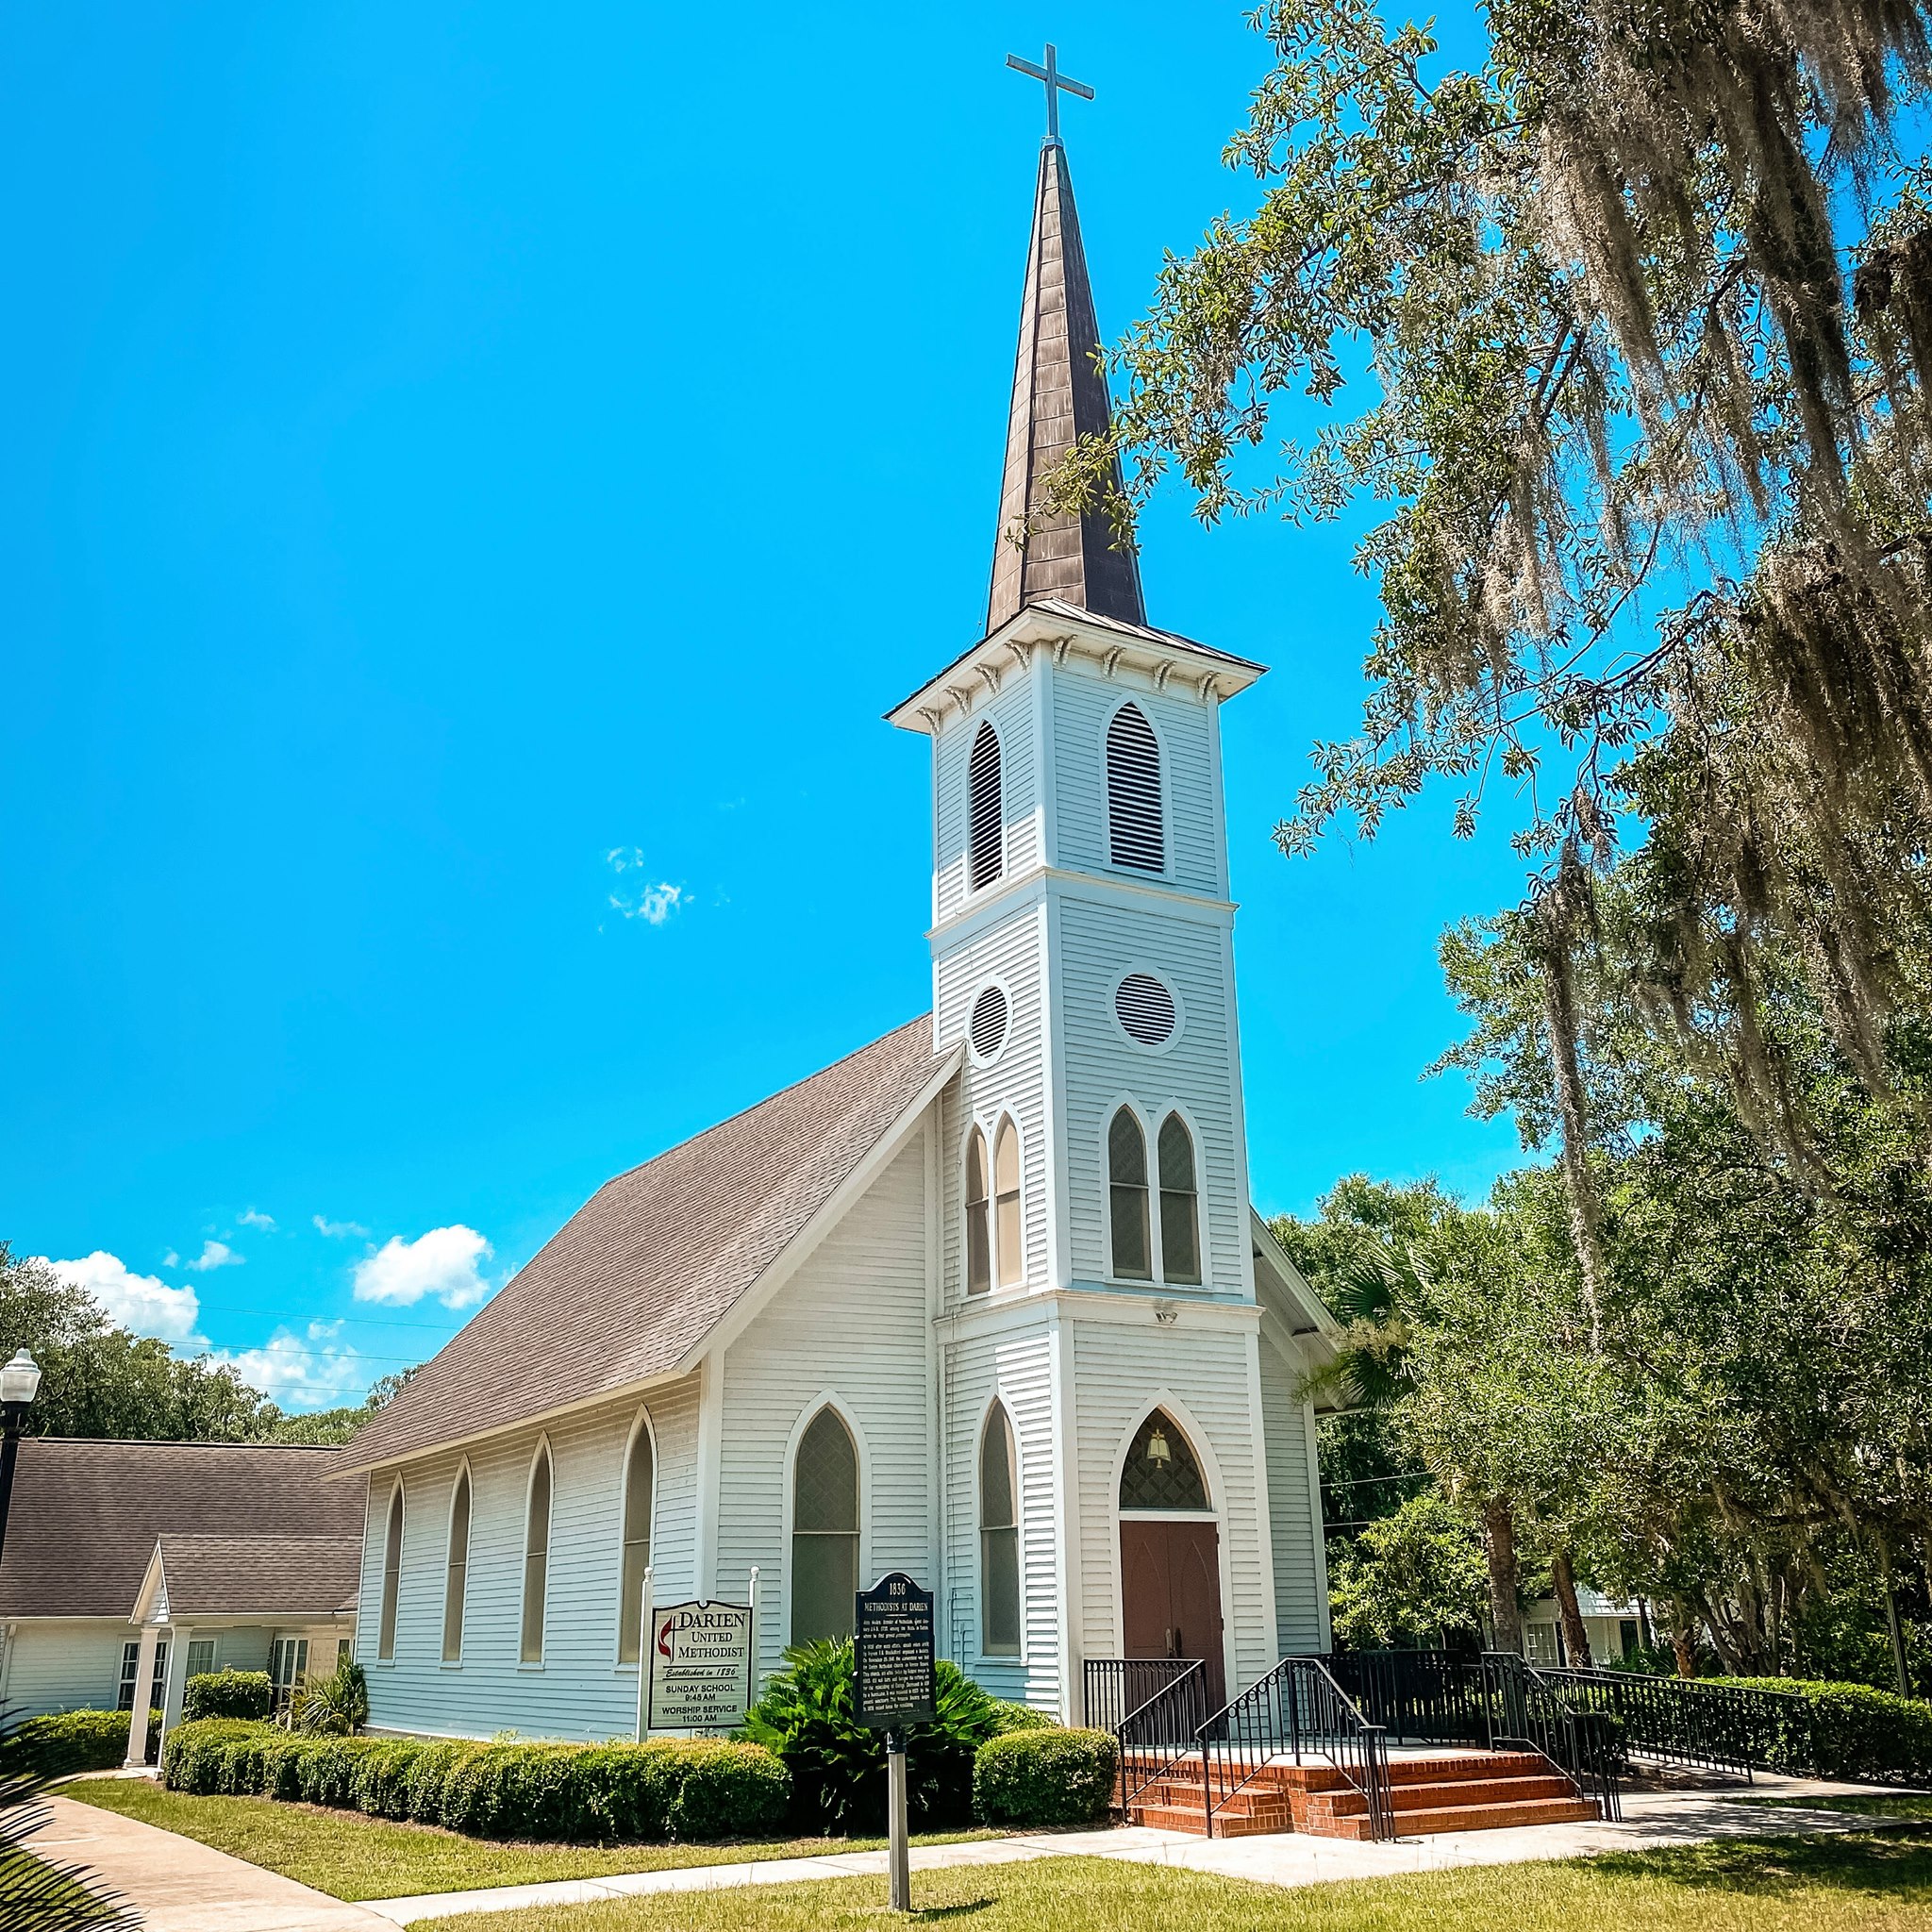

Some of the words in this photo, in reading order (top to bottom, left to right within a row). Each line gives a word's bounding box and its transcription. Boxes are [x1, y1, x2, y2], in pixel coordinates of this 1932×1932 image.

[890, 1582, 906, 1595] 1836
[909, 1602, 928, 1611] DARIEN
[679, 1612, 745, 1628] DARIEN
[691, 1632, 733, 1642] UNITED
[678, 1647, 744, 1658] METHODIST
[666, 1668, 706, 1677] Established
[716, 1668, 736, 1676] 1836
[665, 1685, 699, 1693] SUNDAY
[701, 1684, 735, 1692] SCHOOL
[661, 1706, 701, 1714] WORSHIP
[703, 1705, 738, 1713] SERVICE
